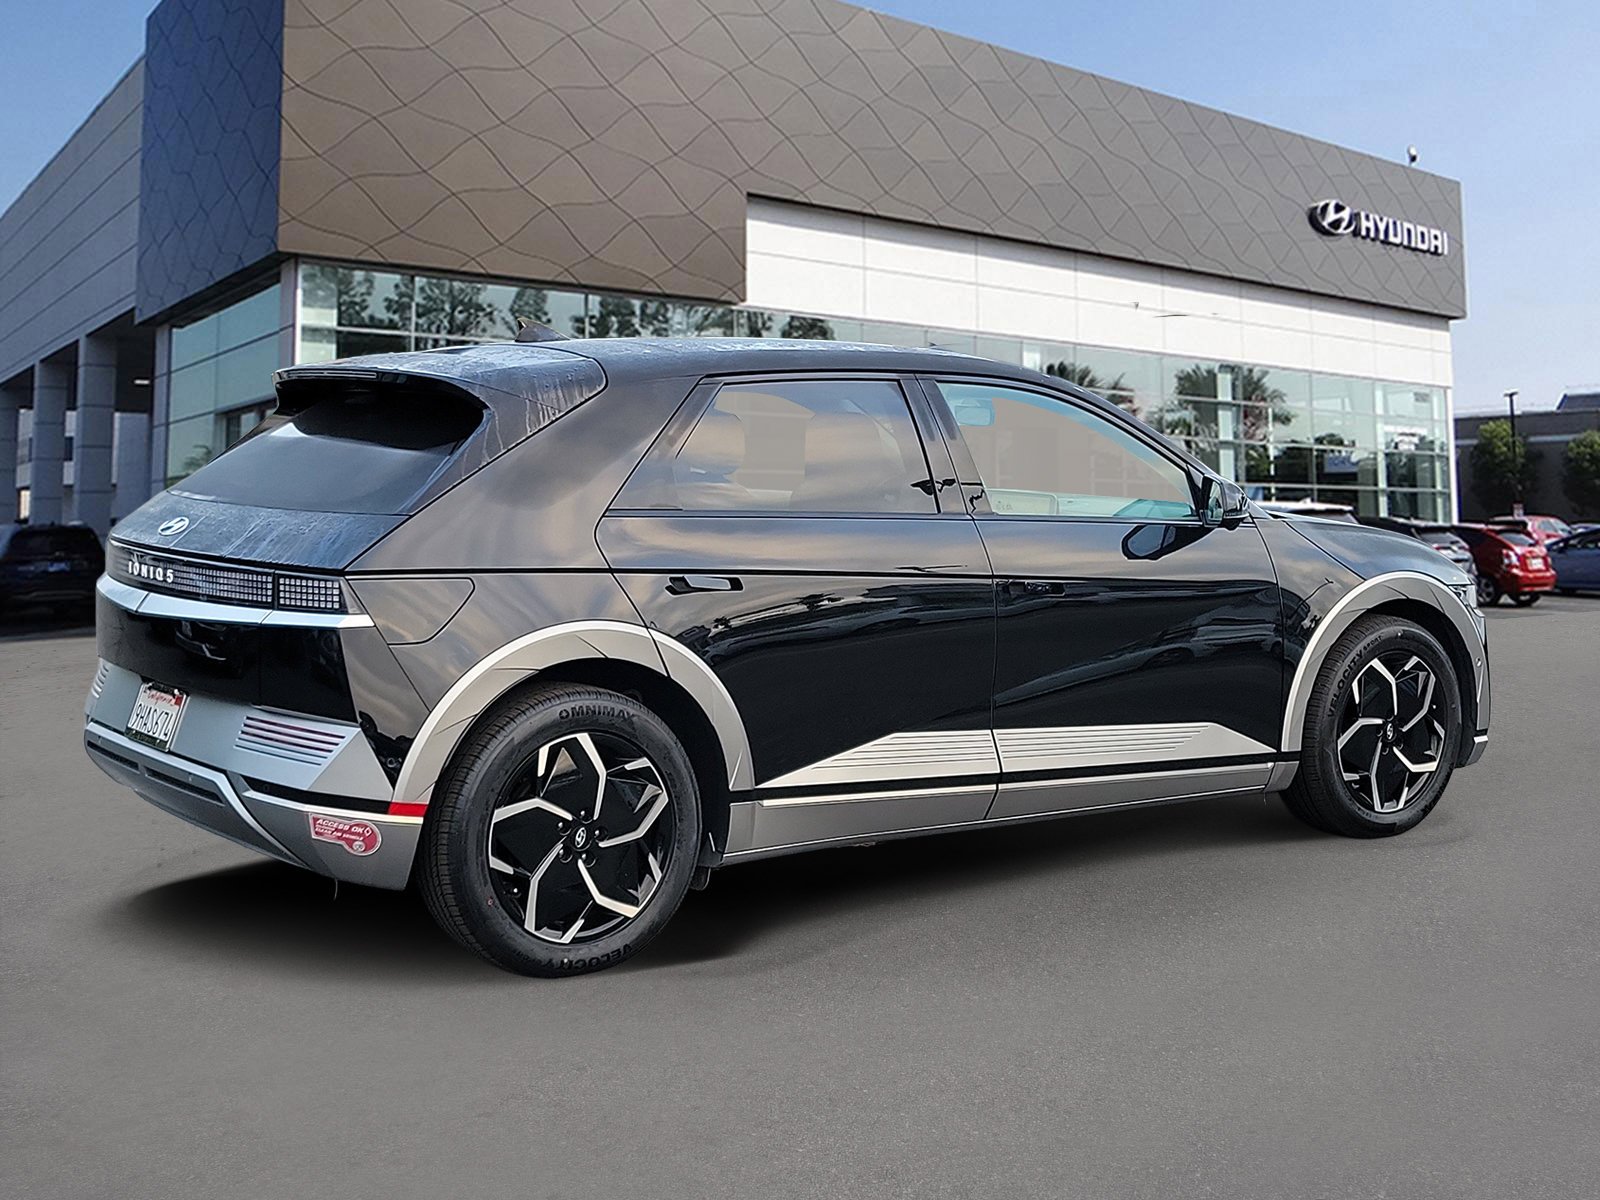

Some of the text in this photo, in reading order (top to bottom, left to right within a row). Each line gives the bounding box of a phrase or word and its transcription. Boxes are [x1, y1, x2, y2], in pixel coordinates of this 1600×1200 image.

[1360, 211, 1448, 255] HYUNDAI
[128, 560, 174, 583] IONIQ 5
[1327, 649, 1363, 717] VELOCITY
[131, 702, 174, 739] 9HAS674
[558, 704, 635, 721] OMNIMAX
[316, 819, 351, 831] ACCESS
[351, 826, 365, 834] OK
